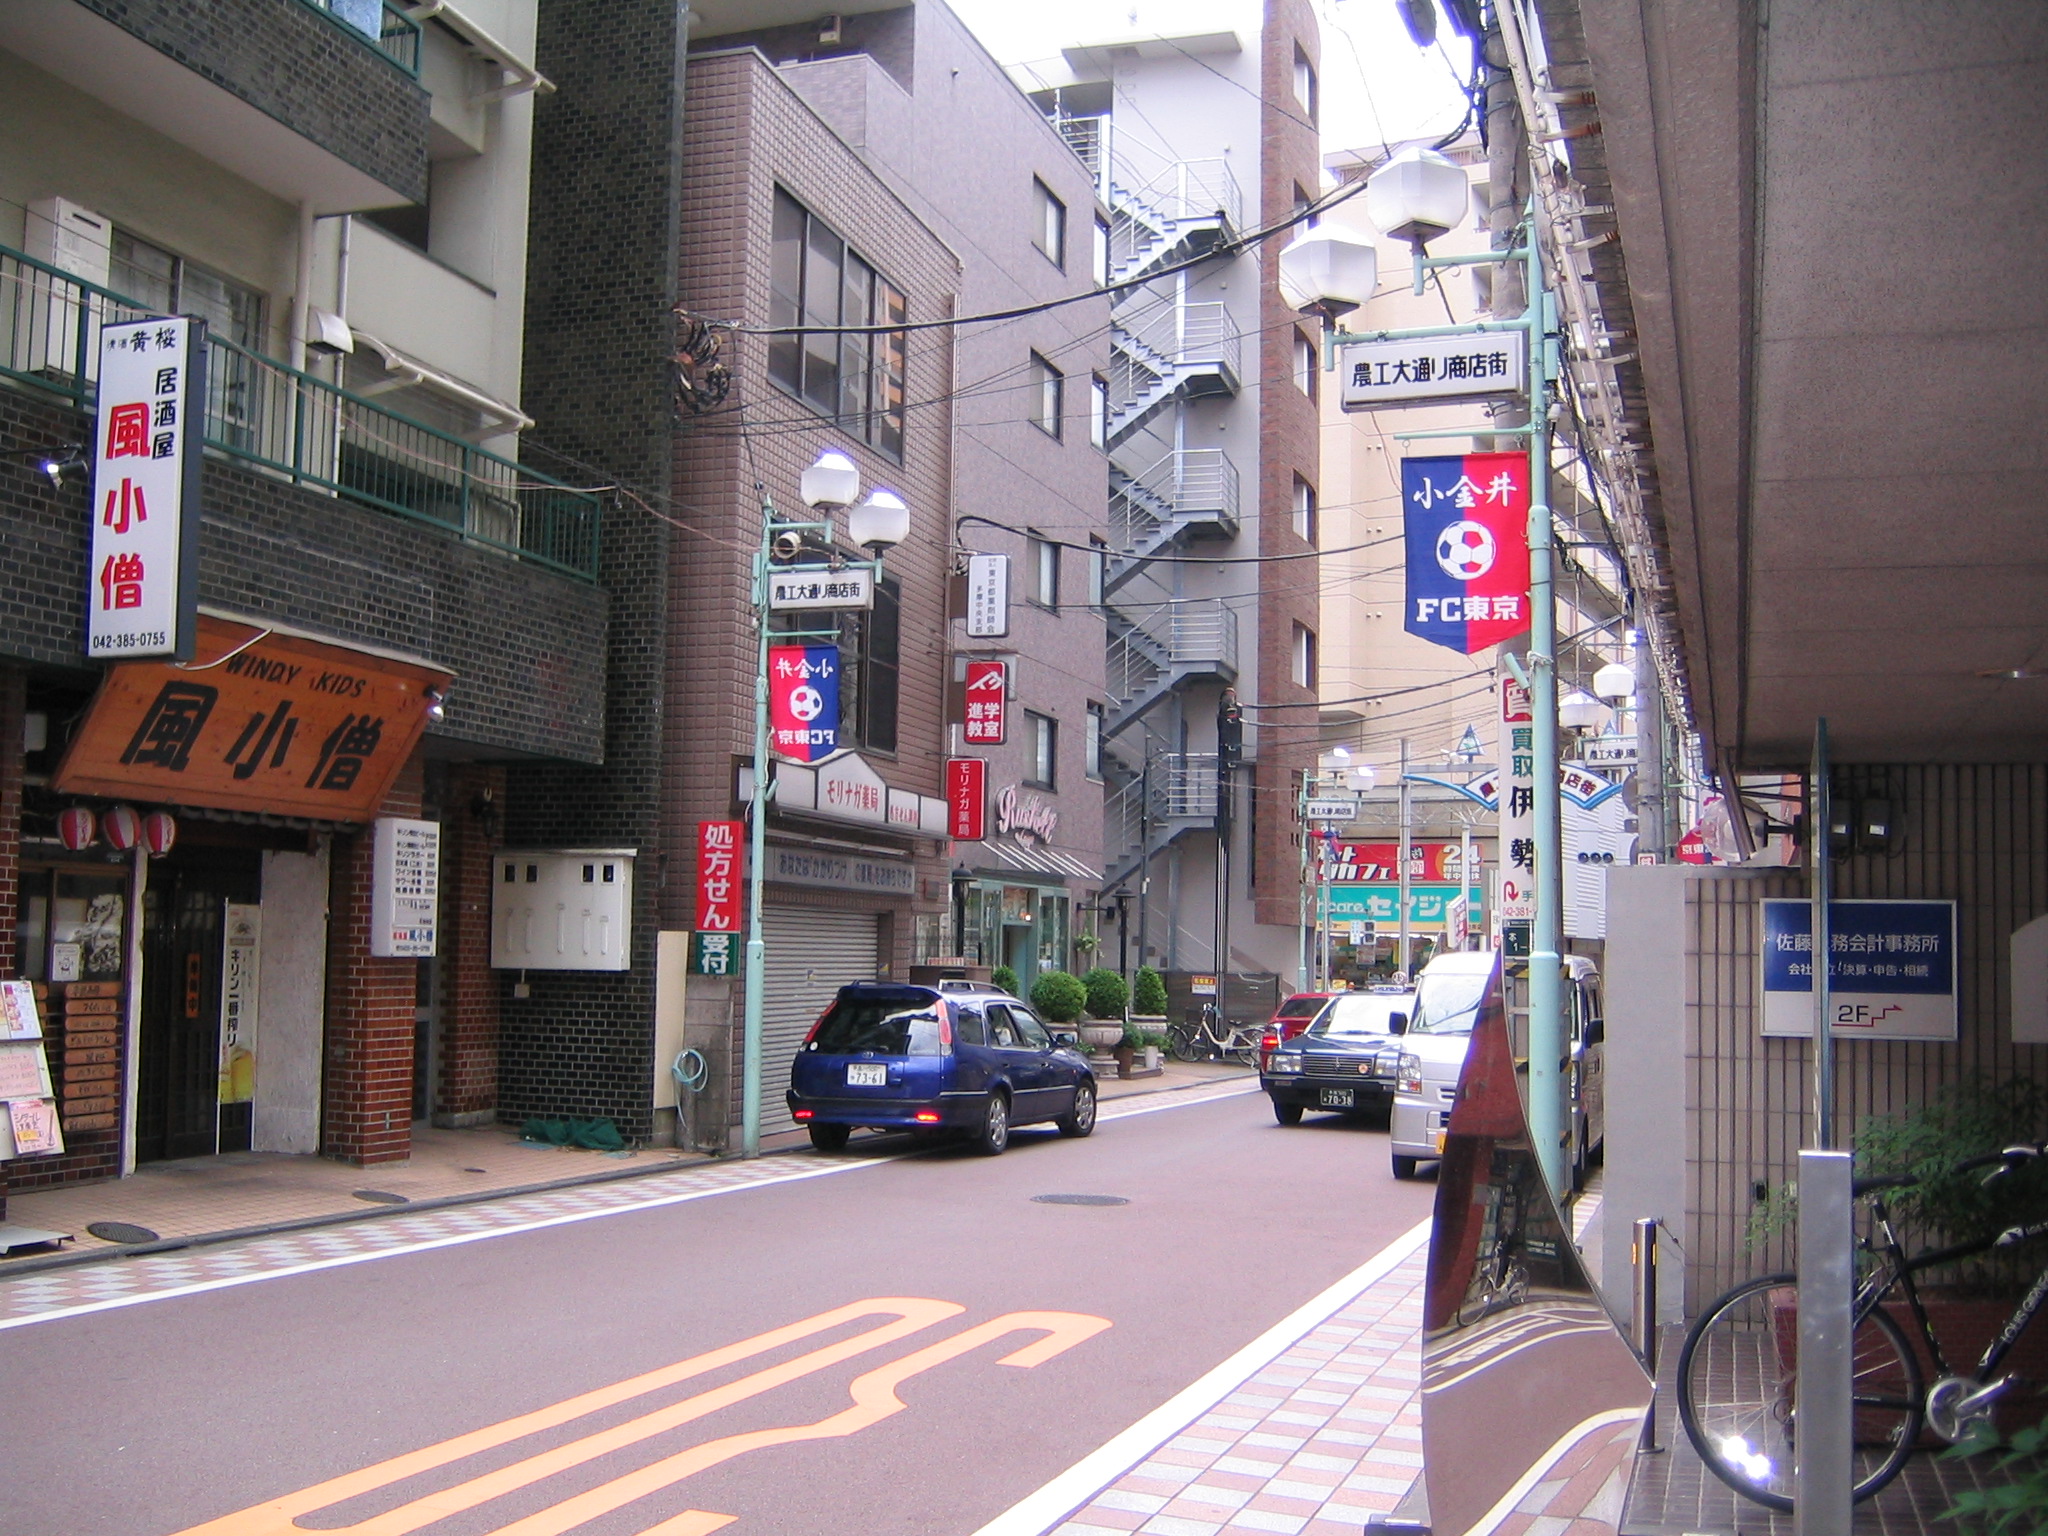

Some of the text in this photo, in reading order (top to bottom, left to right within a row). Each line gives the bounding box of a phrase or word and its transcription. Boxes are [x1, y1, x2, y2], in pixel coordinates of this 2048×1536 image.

[1352, 351, 1508, 388] 農工大通り商店街
[152, 367, 178, 459] 居酒屋
[100, 402, 150, 611] 風小僧
[1413, 471, 1518, 509] 小金井
[1416, 595, 1519, 623] FC東京
[93, 631, 166, 649] 042-385-0755
[225, 652, 368, 698] WINDY KIDS
[967, 702, 1001, 720] 進学
[967, 720, 1000, 738] 教室
[119, 680, 385, 791] 風小僧
[827, 779, 880, 813] モリナガ薬局
[958, 762, 971, 837] モリナガ薬局
[703, 824, 734, 930] 処方せん
[701, 934, 730, 975] 受付
[1776, 933, 1940, 954] 佐藤務会計事務所
[1838, 1004, 1869, 1022] 2F
